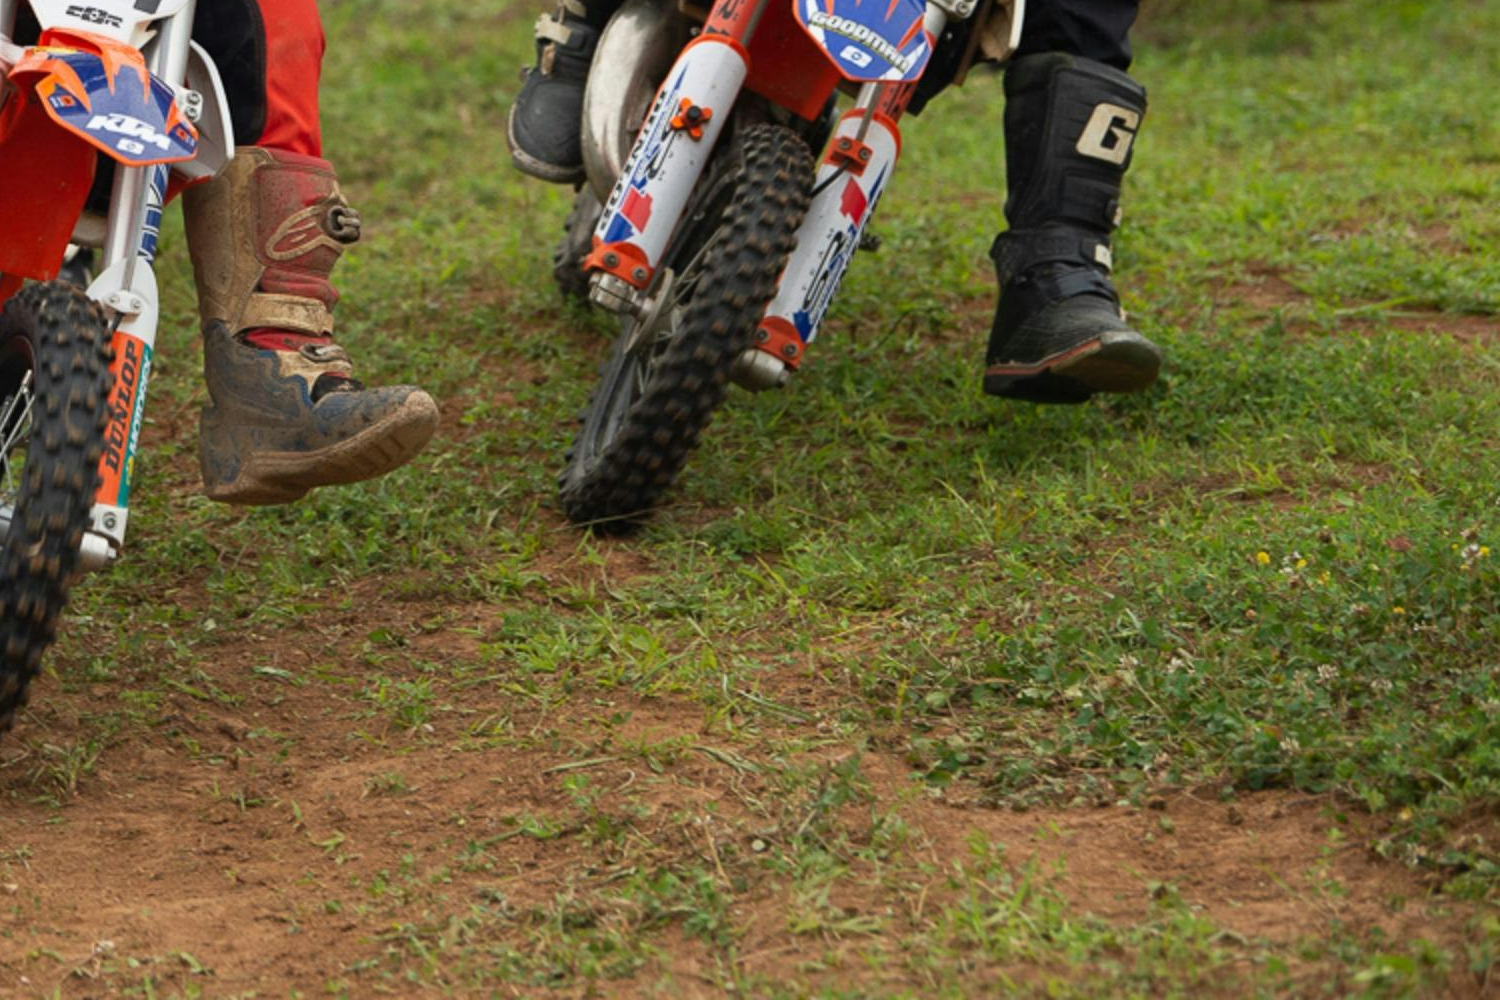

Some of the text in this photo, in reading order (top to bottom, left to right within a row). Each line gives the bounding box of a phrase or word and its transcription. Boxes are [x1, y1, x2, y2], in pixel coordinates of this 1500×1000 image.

[810, 11, 911, 74] GOODMAN
[85, 112, 172, 151] KTM
[106, 339, 138, 475] DUNLOP
